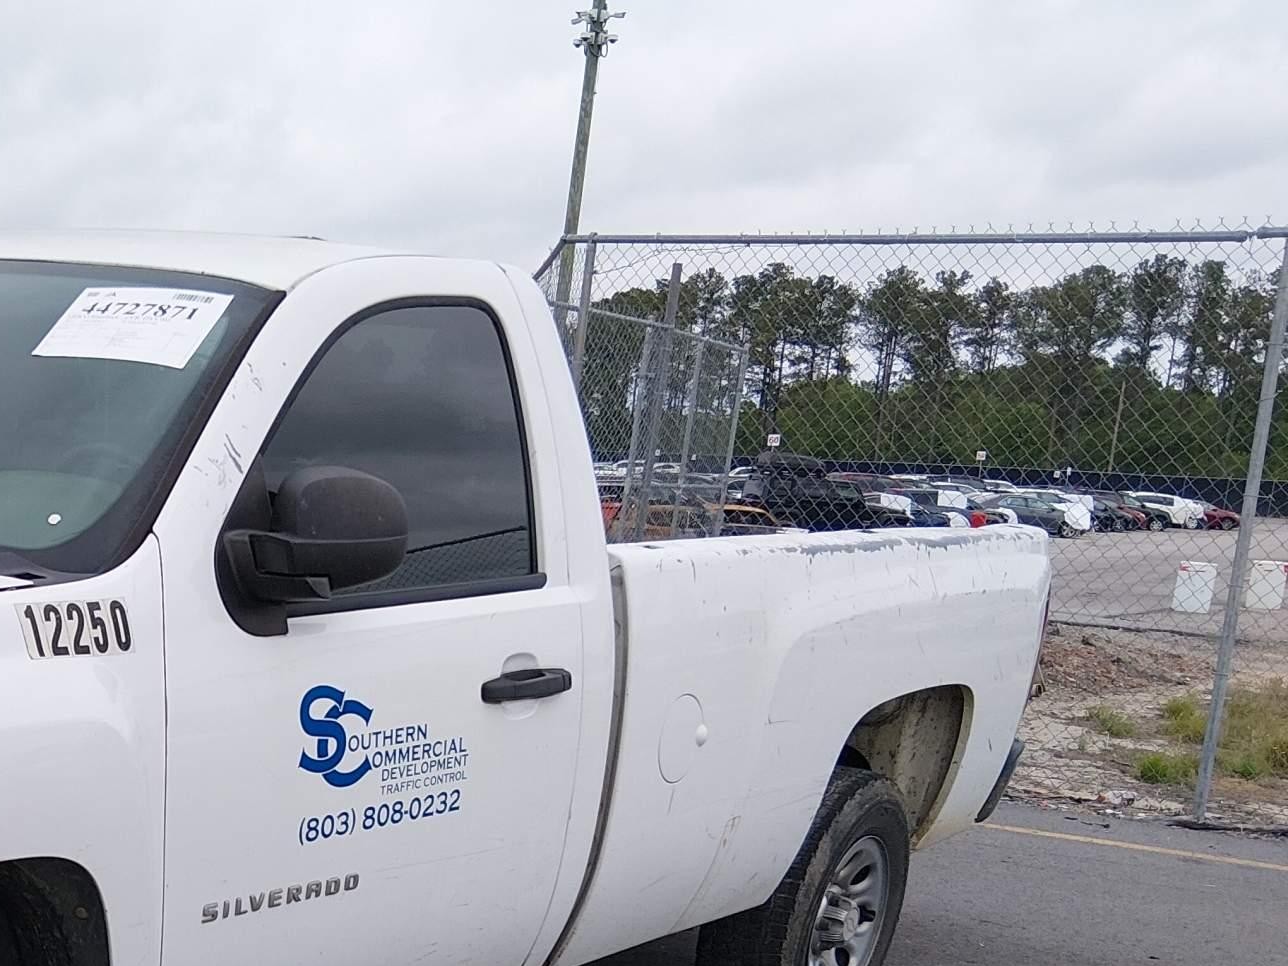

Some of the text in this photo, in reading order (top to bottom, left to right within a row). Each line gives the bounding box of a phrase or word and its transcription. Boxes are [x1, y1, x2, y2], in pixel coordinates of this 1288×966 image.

[82, 302, 199, 320] 44727871
[24, 600, 132, 657] 12250
[381, 754, 469, 782] DEVELOPMENT
[381, 770, 468, 796] TRAFFIC CONTROL
[299, 789, 461, 845] (803) 808-0232
[201, 873, 360, 924] SILVERADO
